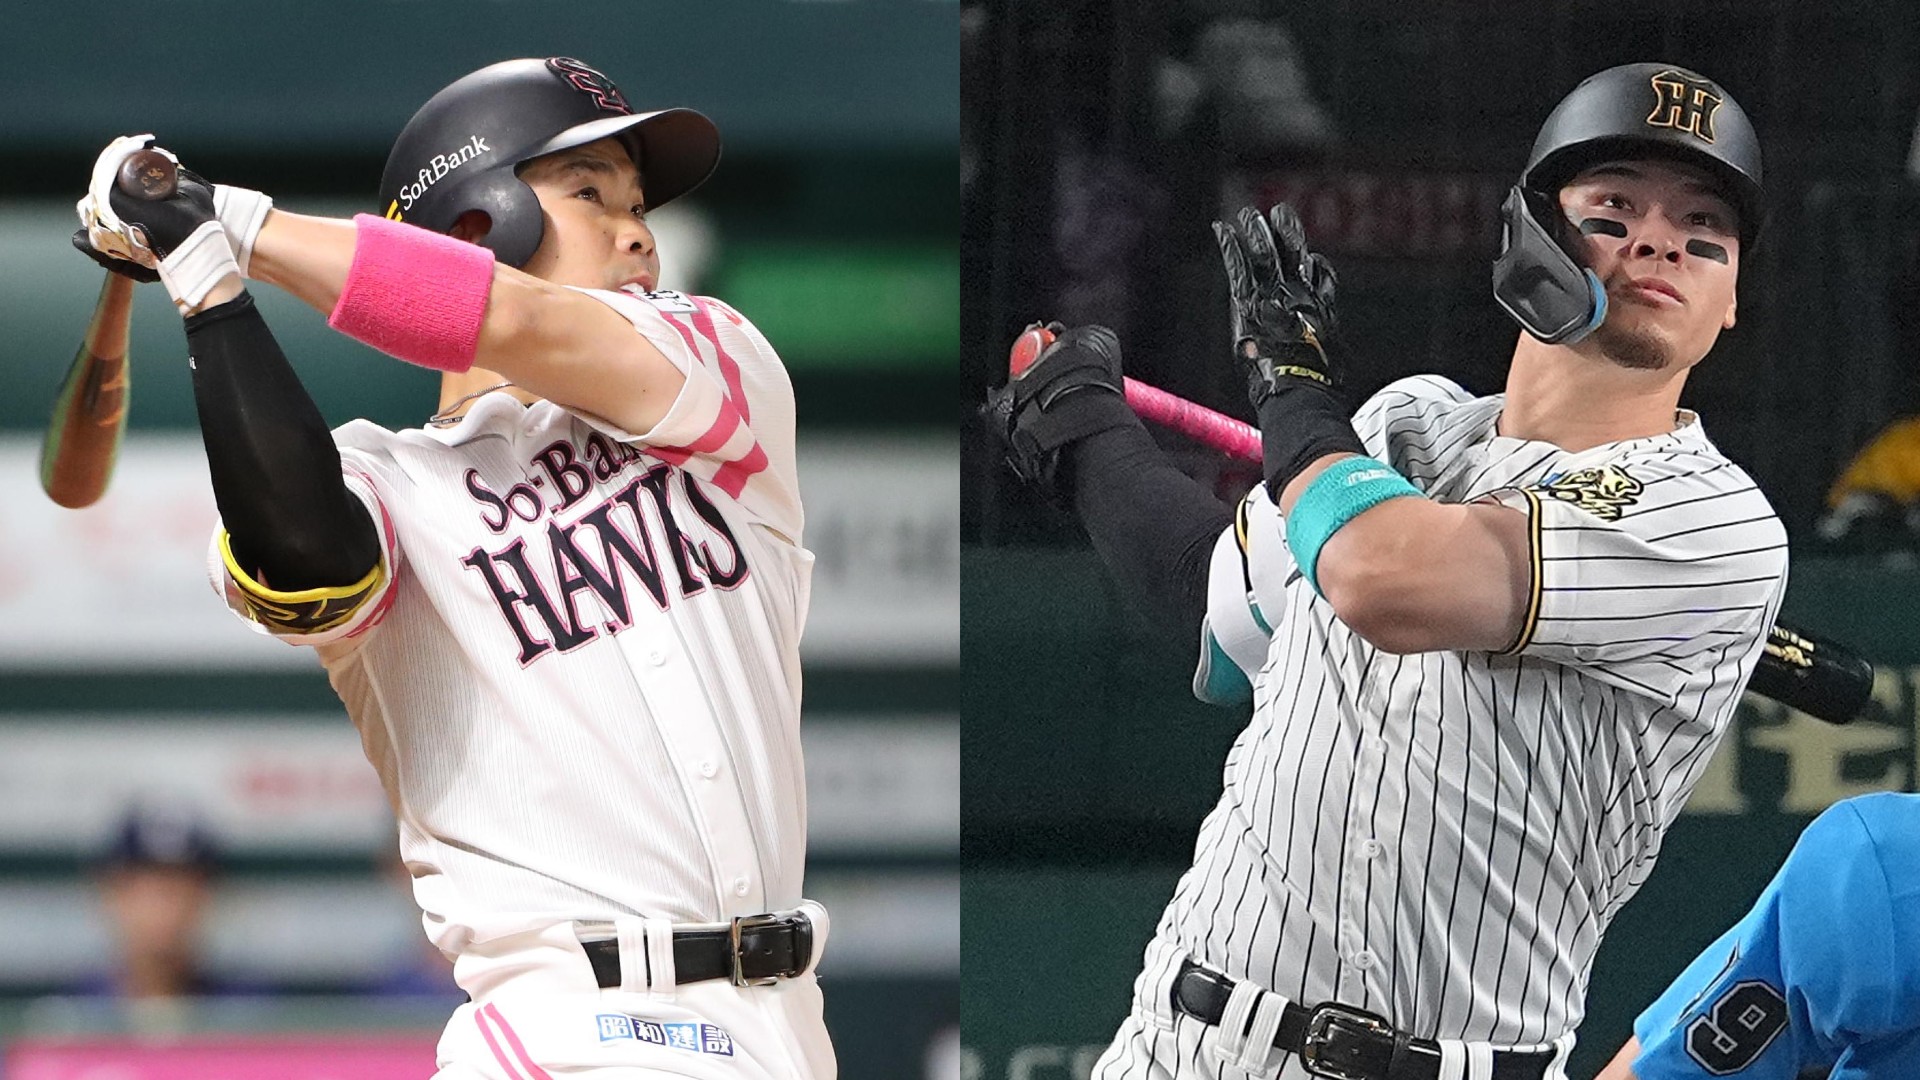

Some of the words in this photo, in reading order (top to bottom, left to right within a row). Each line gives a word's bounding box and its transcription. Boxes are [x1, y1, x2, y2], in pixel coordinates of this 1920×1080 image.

[399, 134, 491, 211] SoftBank
[598, 1014, 735, 1056] 昭和建設
